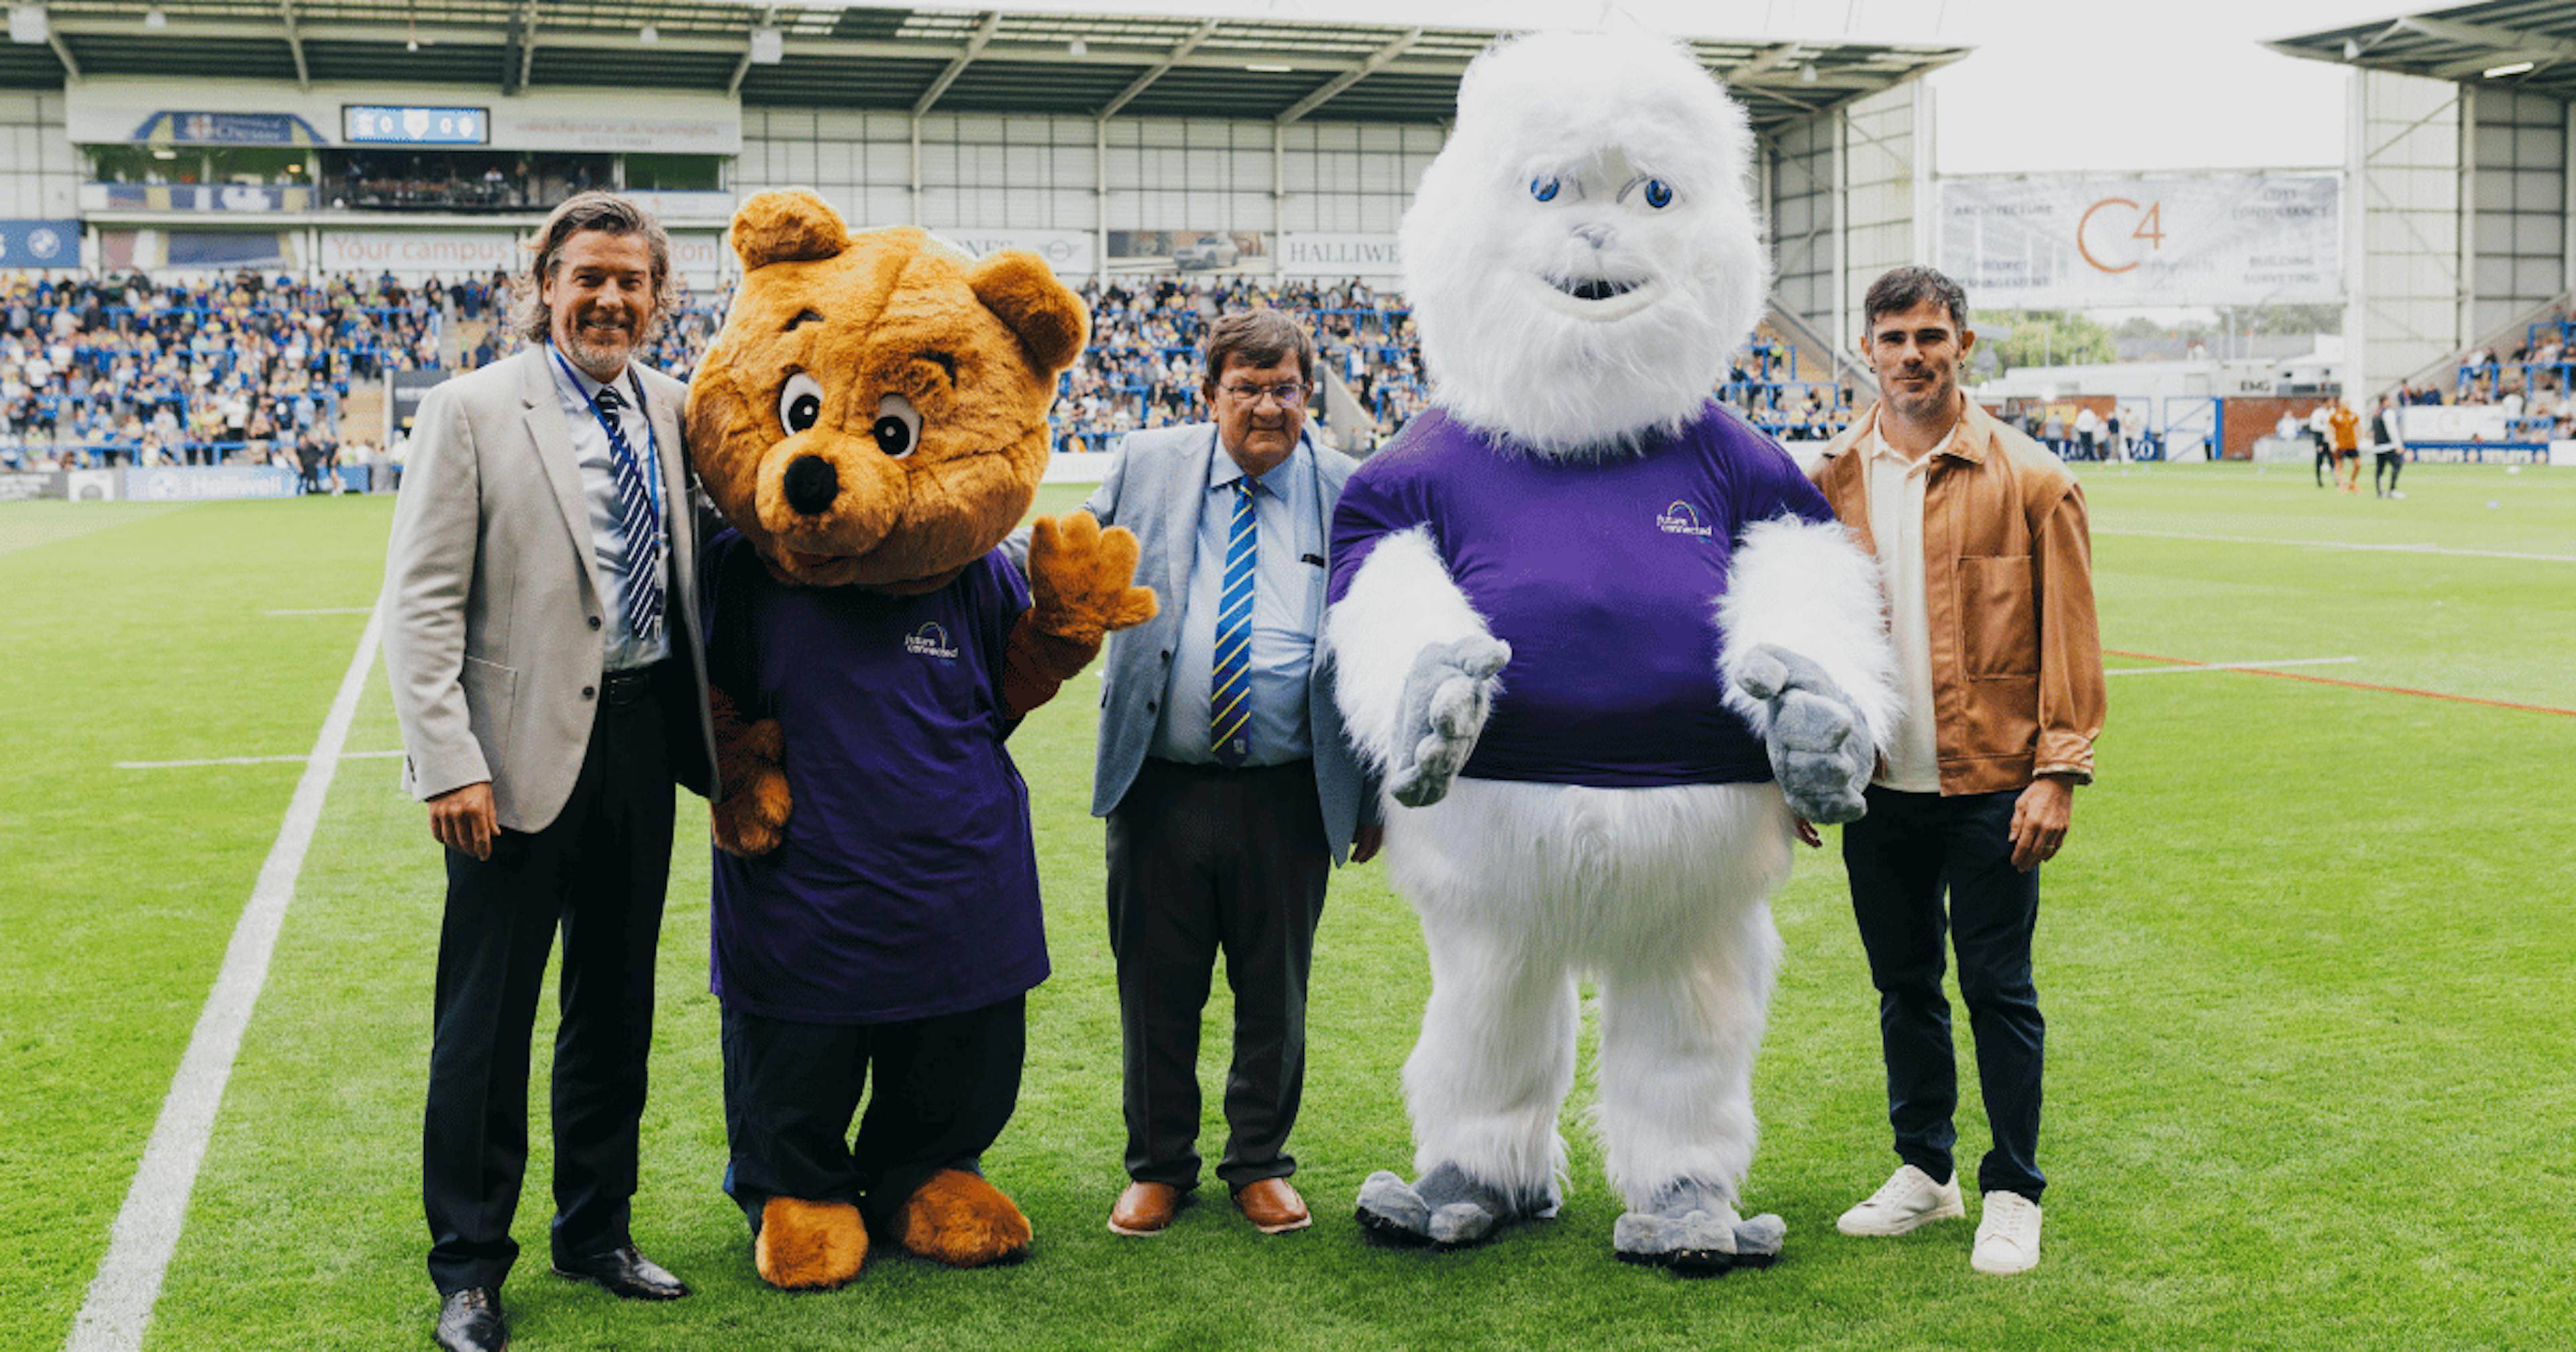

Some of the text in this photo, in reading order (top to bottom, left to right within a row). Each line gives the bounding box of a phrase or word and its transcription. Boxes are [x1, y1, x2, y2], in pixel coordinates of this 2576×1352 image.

[1953, 205, 2053, 215] ARCHITECTURE
[2077, 197, 2166, 274] C4
[332, 236, 507, 262] Your campus
[2249, 256, 2314, 268] BUILDING
[2243, 274, 2320, 285] SURVEYING
[2241, 381, 2270, 391] EMG
[1656, 514, 1687, 526] future
[1660, 524, 1712, 537] connected
[904, 633, 935, 646] future
[907, 644, 959, 658] connected
